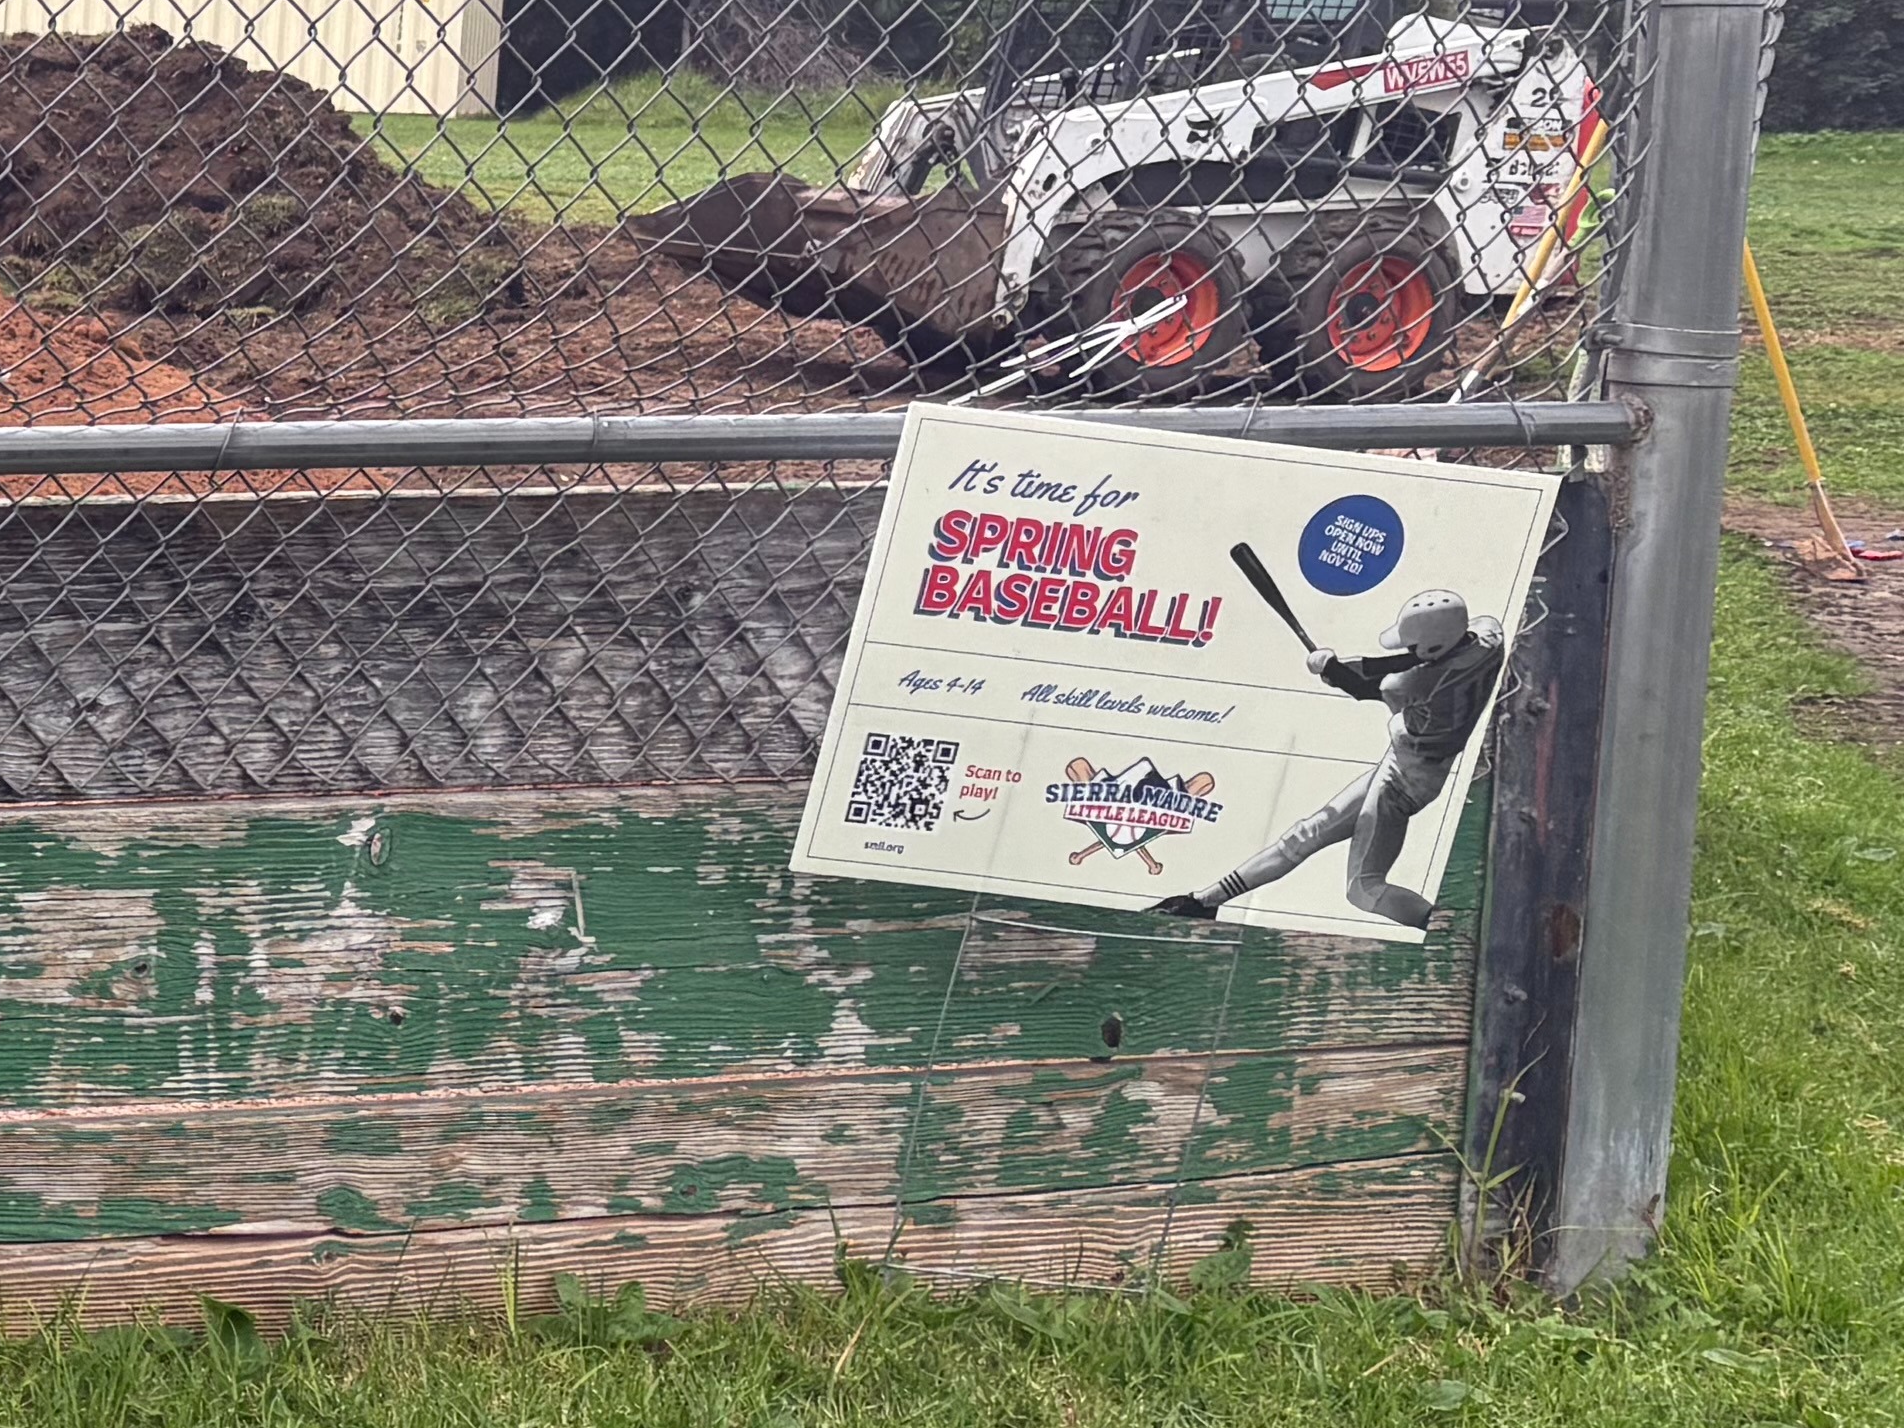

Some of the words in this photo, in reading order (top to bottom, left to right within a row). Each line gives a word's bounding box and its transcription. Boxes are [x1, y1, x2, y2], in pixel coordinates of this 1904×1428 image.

[948, 459, 1005, 494] It's
[1010, 469, 1078, 503] time
[1073, 474, 1140, 516] for
[1324, 525, 1355, 544] OPEN
[1354, 536, 1385, 556] NOW
[1334, 515, 1364, 534] SIGN
[1362, 525, 1387, 543] UPS
[929, 509, 1139, 581] SPRING
[1318, 549, 1345, 567] NOV
[1330, 540, 1362, 562] UNTIL
[914, 564, 1222, 647] BASEBALL!
[897, 670, 941, 695] Ages
[945, 677, 986, 695] 4-14
[1021, 684, 1058, 704] All
[1053, 688, 1095, 708] skill
[1095, 695, 1145, 715] levels
[1146, 700, 1236, 724] welcome!
[965, 764, 1002, 781] Scan
[1005, 769, 1022, 783] to
[959, 783, 999, 802] play!
[1045, 782, 1133, 804] SIERRA
[1142, 785, 1224, 823] MADRE
[1068, 804, 1126, 821] LITTLE
[1127, 807, 1192, 830] LEAGUE
